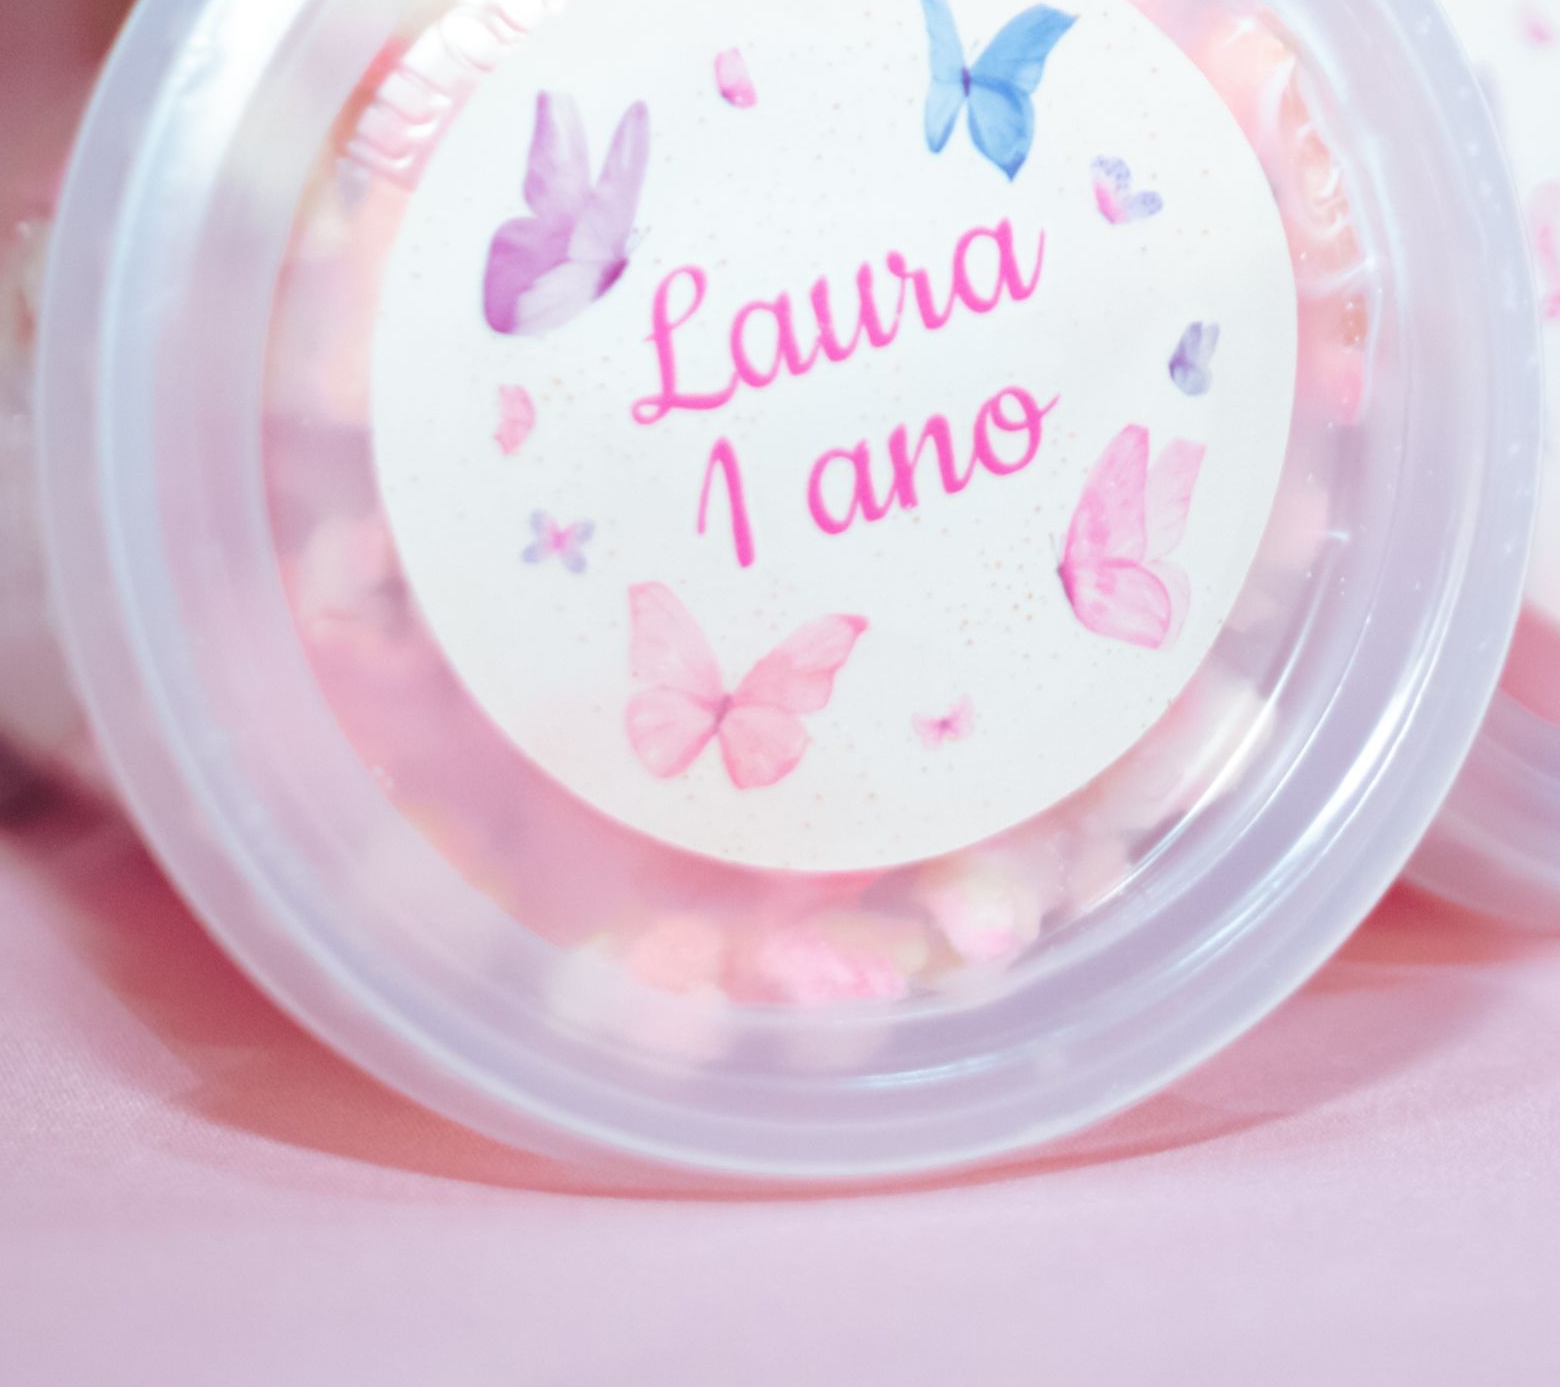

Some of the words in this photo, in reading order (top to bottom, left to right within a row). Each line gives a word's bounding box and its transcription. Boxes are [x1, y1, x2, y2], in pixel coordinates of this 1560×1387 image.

[630, 217, 1046, 425] Laura
[696, 435, 755, 568] 1
[805, 385, 1061, 535] ano
